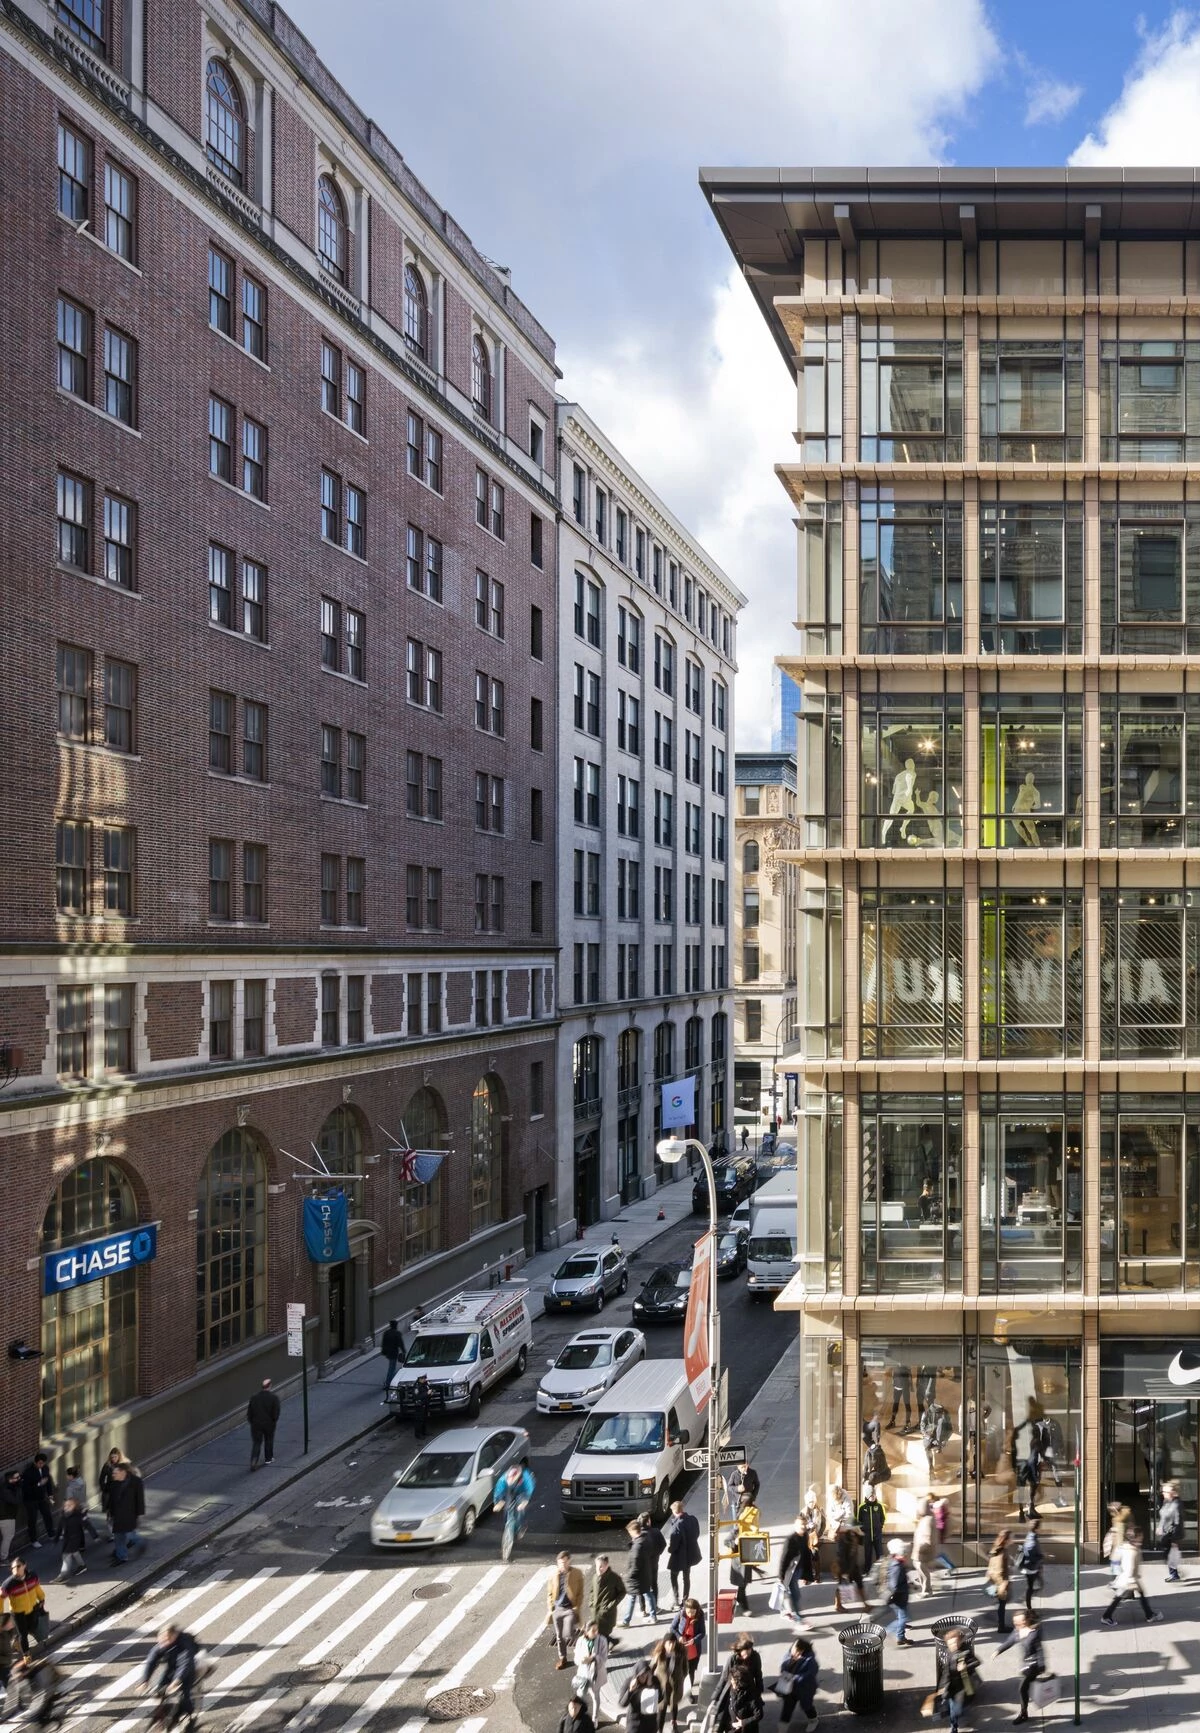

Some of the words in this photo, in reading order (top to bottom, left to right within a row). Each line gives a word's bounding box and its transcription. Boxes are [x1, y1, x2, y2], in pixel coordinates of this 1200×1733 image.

[321, 1205, 333, 1245] CHASE
[56, 1240, 131, 1283] CHASE
[500, 1305, 523, 1328] ALLSTATE
[692, 1454, 710, 1463] ONE
[719, 1452, 737, 1461] WAY
